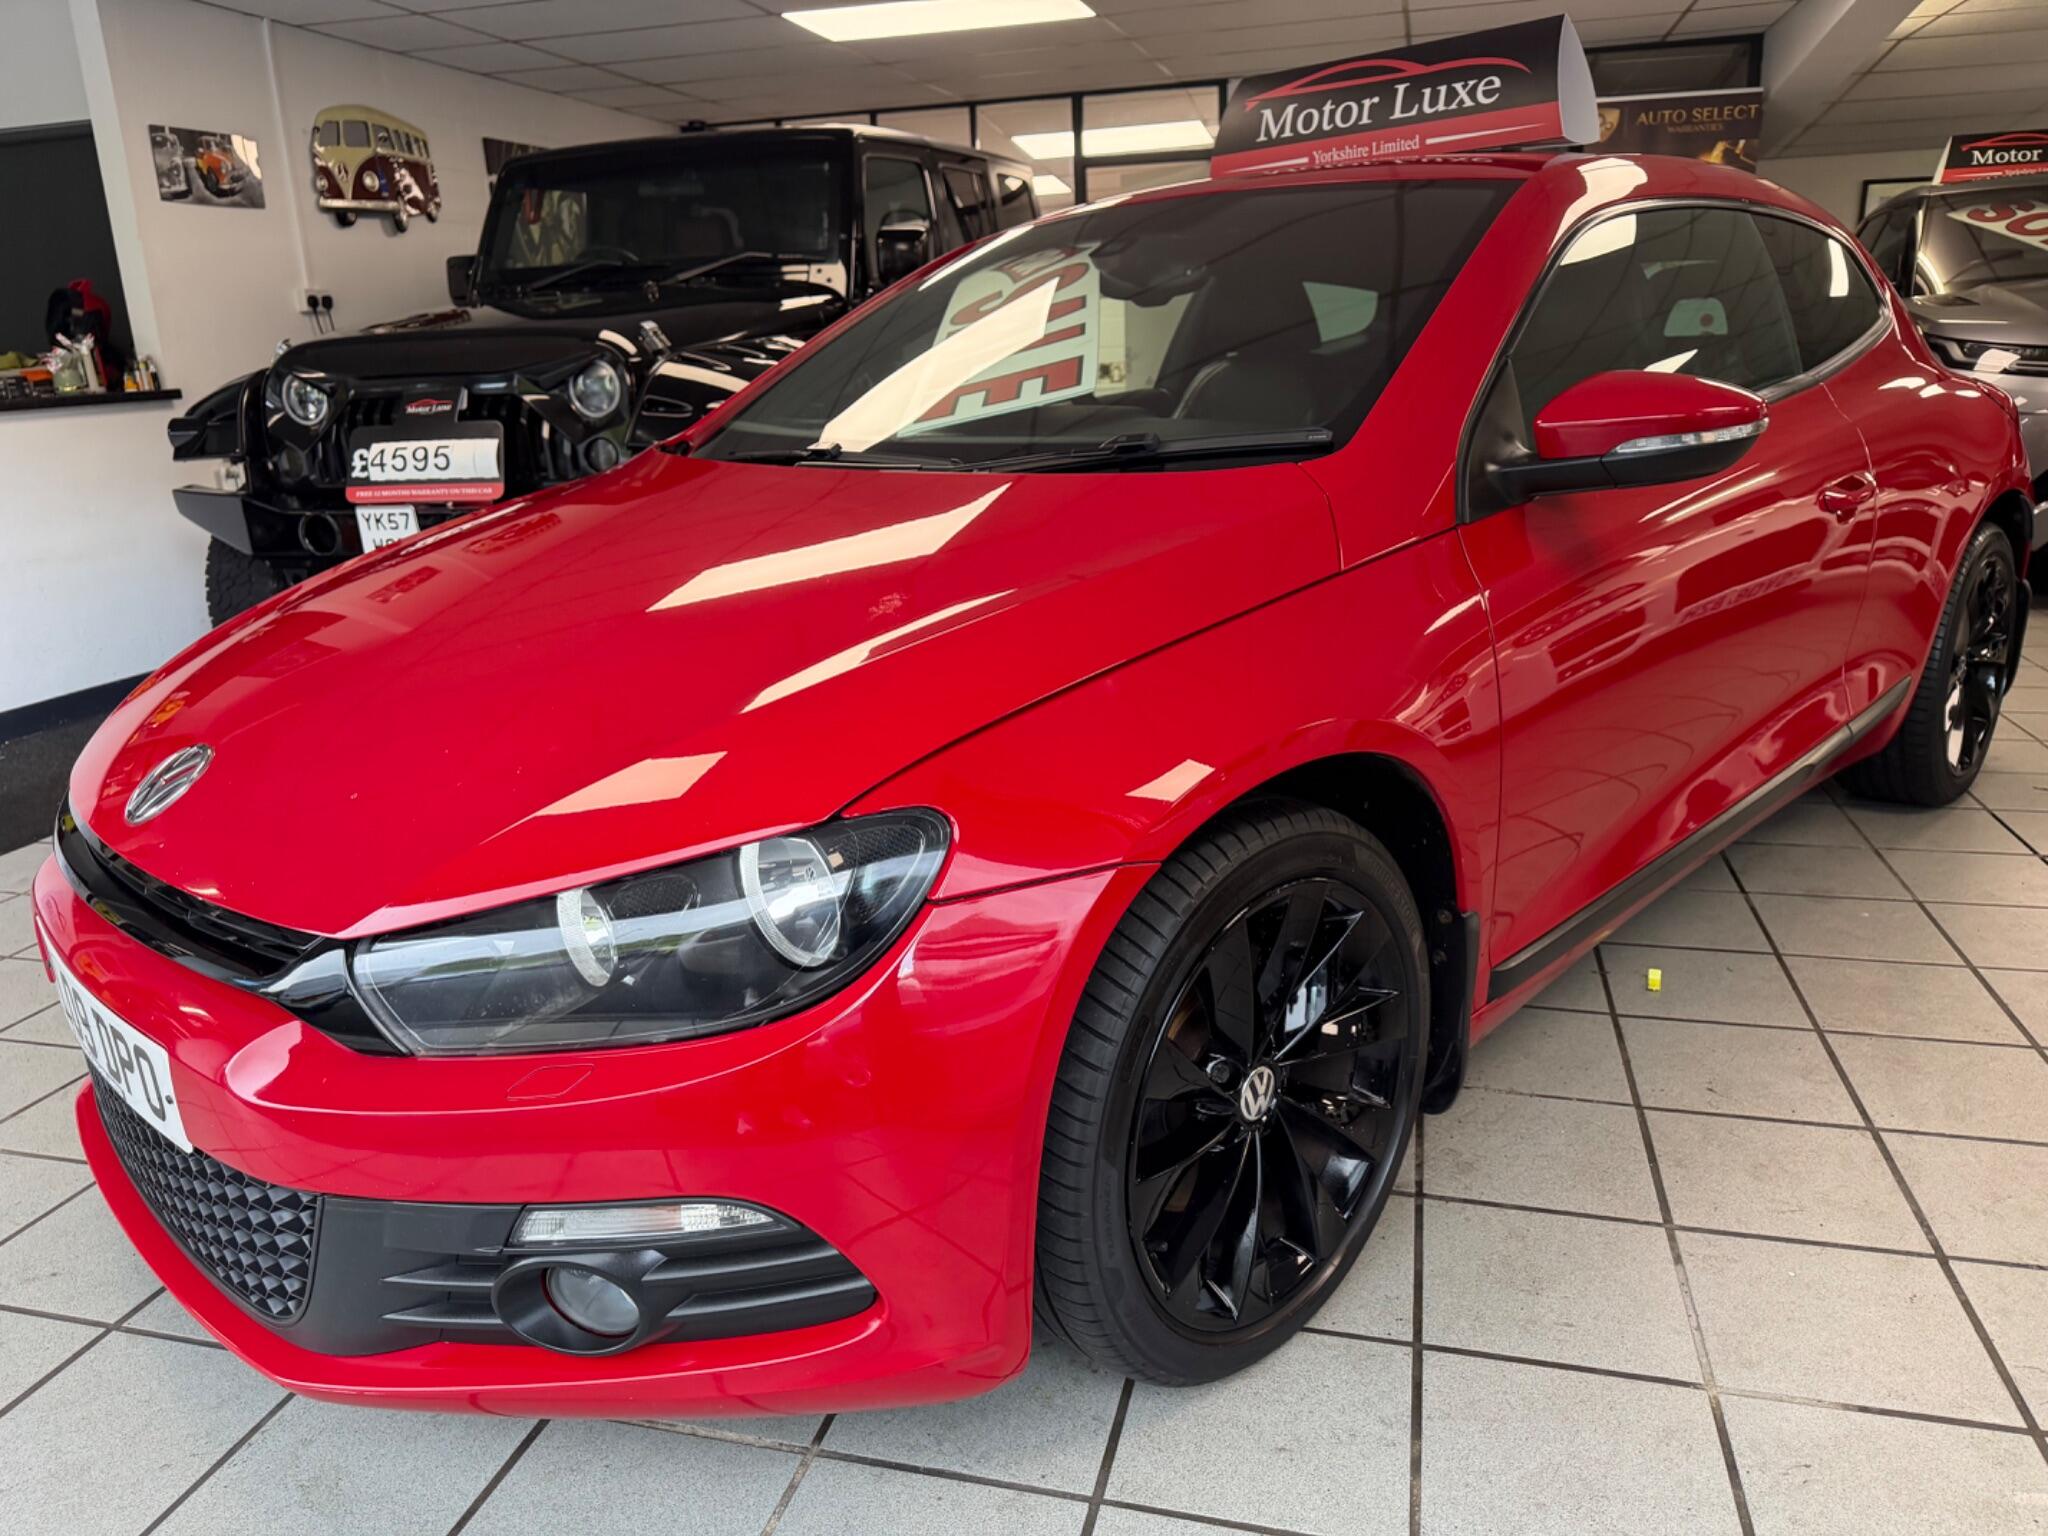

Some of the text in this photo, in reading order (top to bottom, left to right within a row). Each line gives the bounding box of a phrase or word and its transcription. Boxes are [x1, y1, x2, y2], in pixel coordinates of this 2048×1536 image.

[1256, 73, 1502, 143] Motor Luxe
[1636, 104, 1759, 127] AUTO SELECT
[1312, 135, 1420, 165] Yorkshire Limited
[1971, 148, 2043, 166] Motor
[351, 445, 451, 479] £4595
[362, 512, 411, 531] YK57
